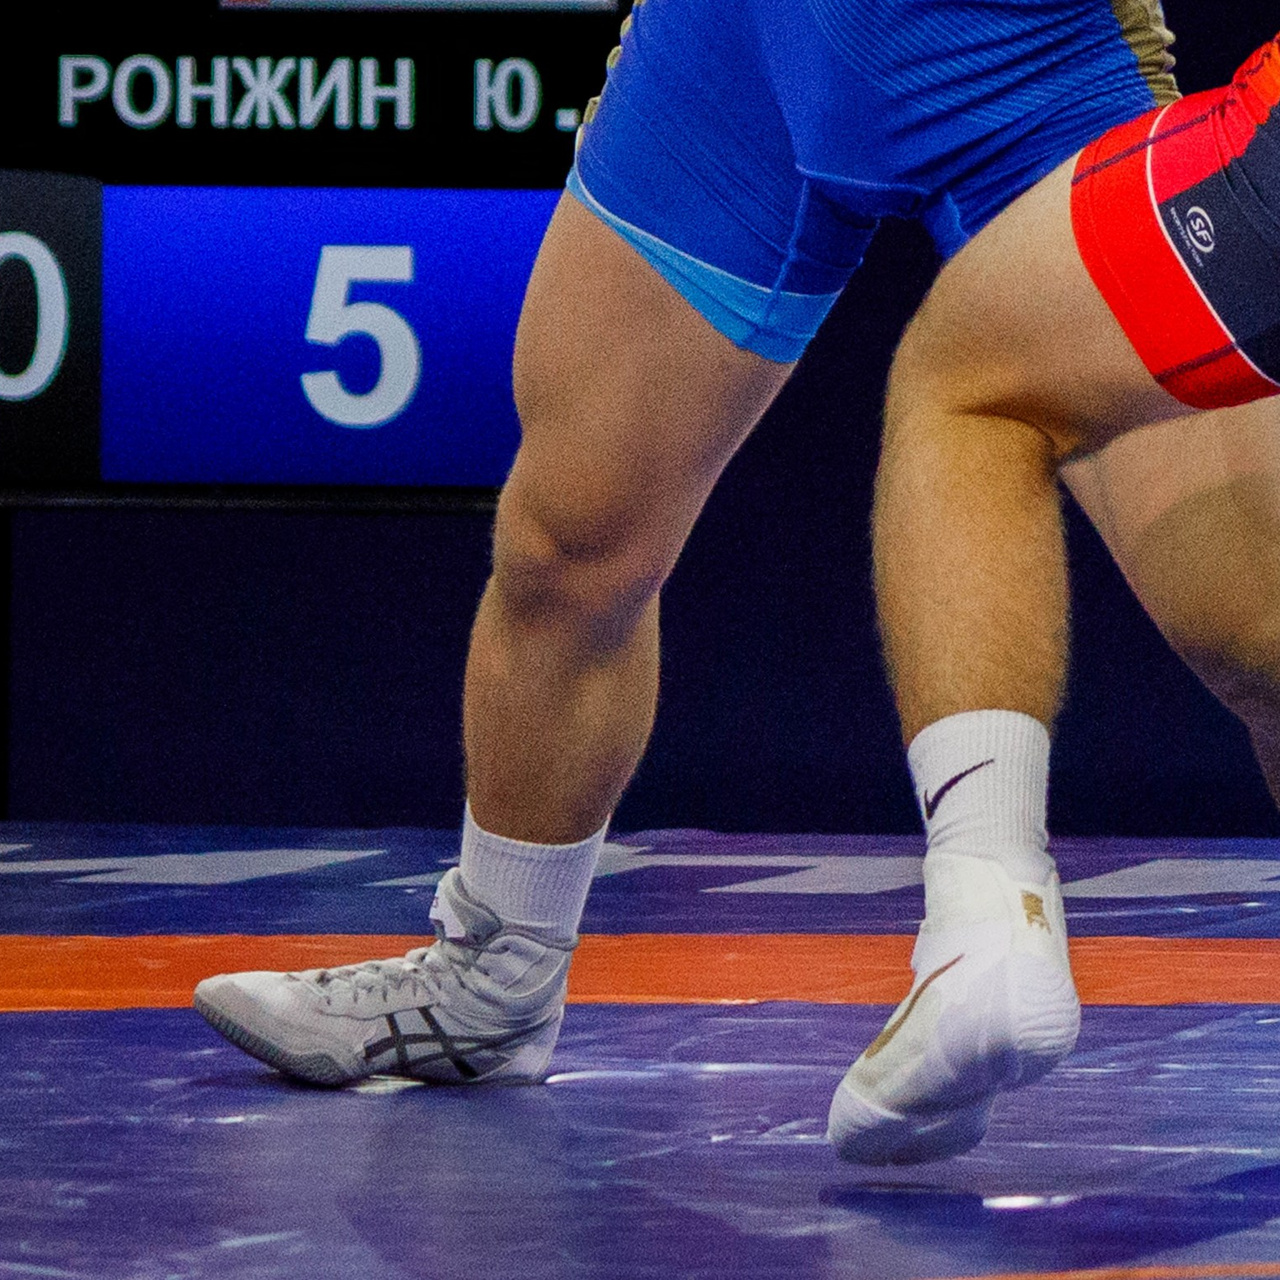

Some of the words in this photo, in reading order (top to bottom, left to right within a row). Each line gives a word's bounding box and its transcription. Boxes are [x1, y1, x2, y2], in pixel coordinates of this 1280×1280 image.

[57, 53, 416, 128] РОНЖИН
[473, 56, 579, 131] Ю.
[1189, 217, 1213, 243] SF
[300, 244, 423, 429] 5
